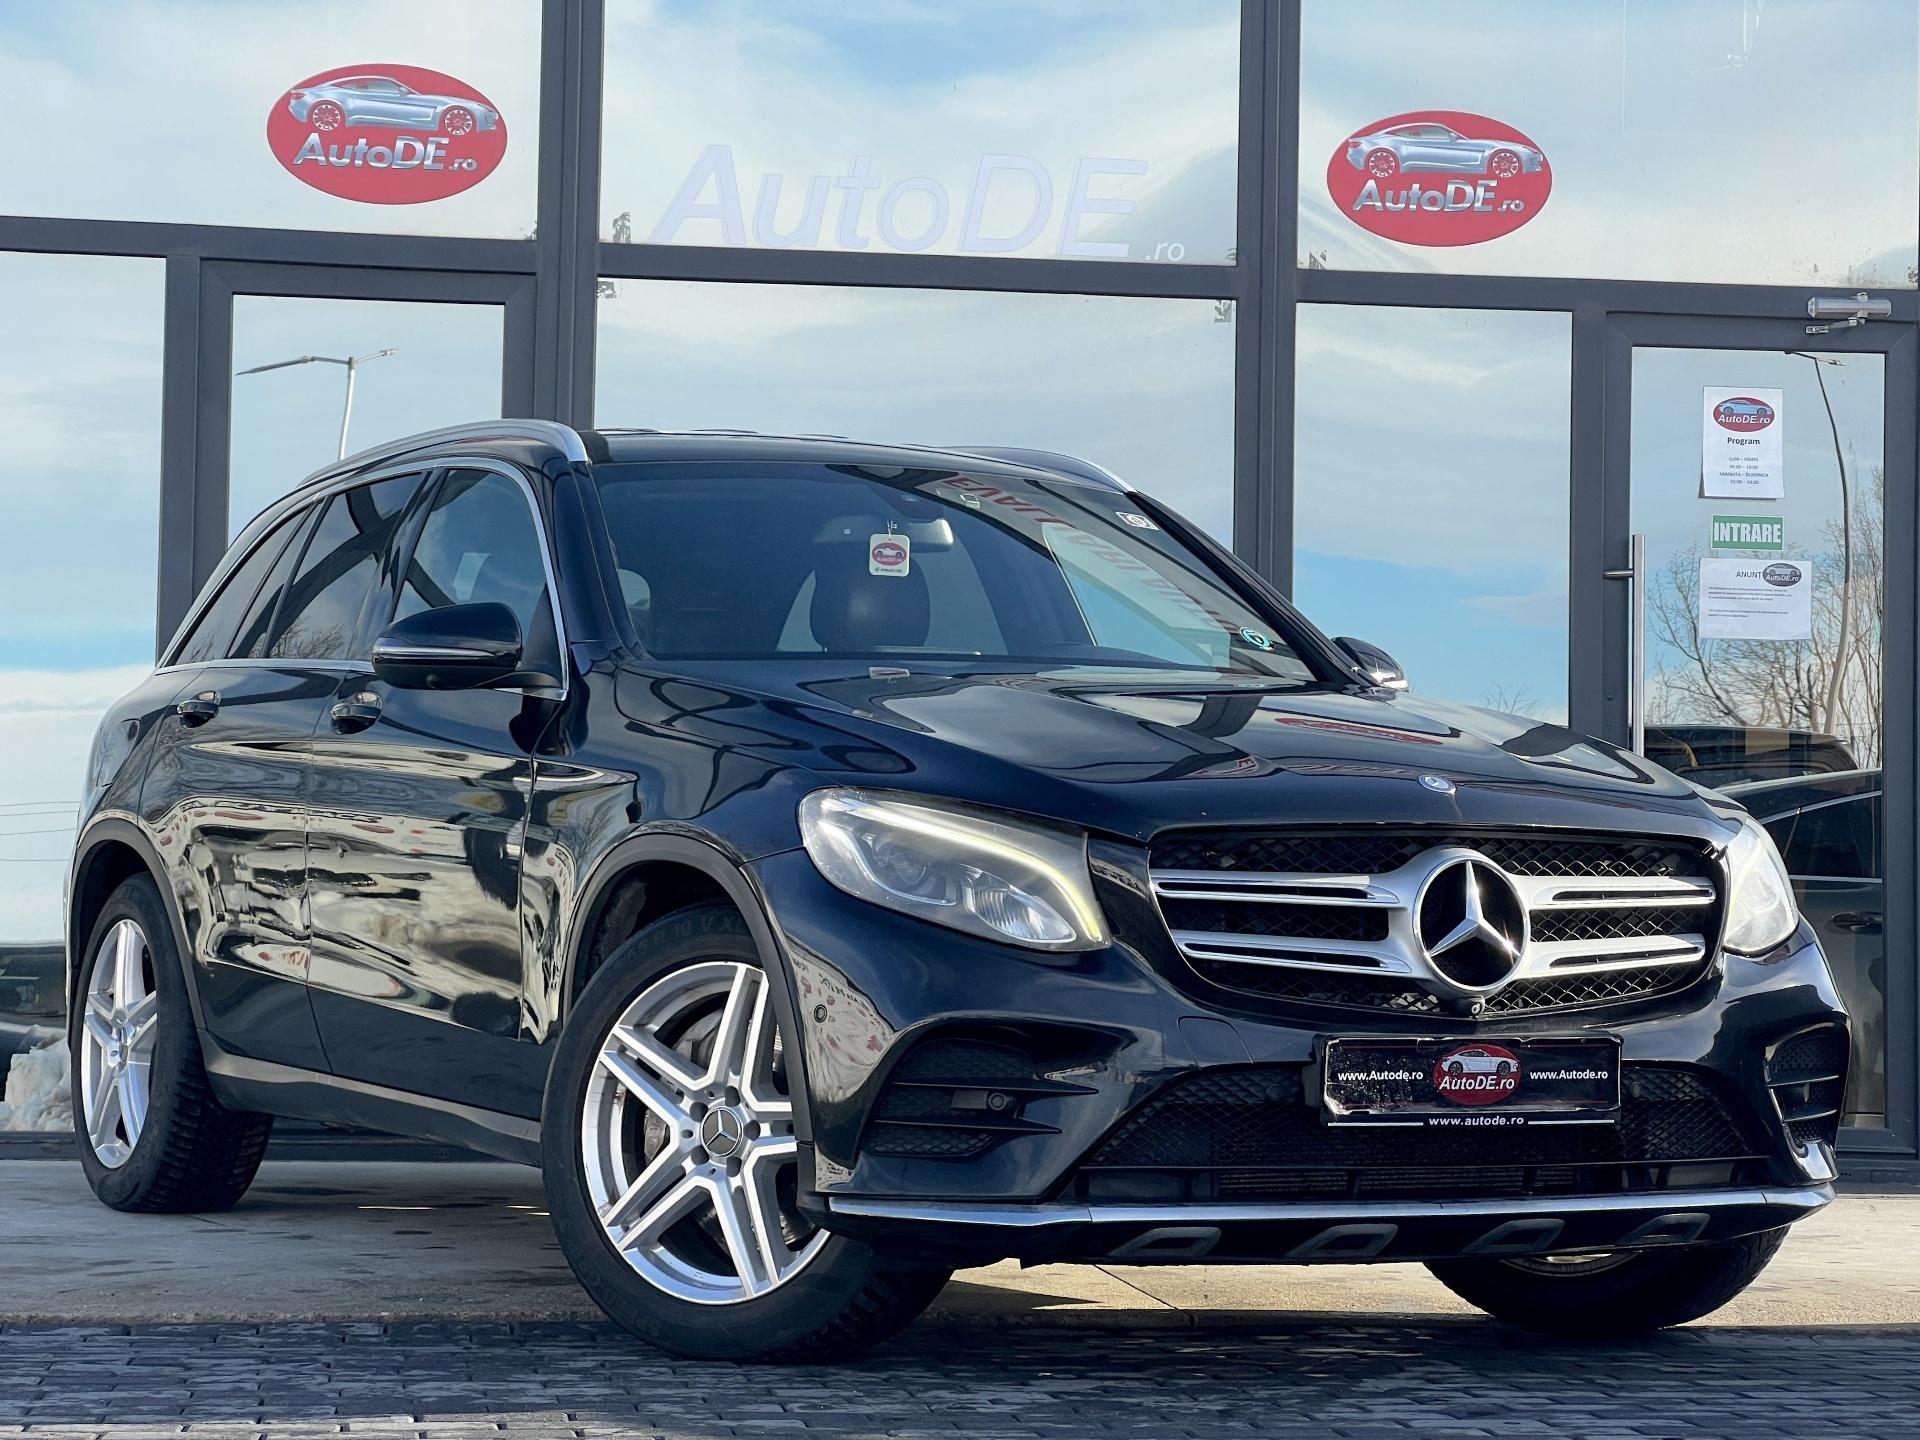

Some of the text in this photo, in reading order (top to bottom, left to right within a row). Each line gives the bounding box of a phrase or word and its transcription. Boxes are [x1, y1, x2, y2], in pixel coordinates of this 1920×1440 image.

[1718, 414, 1771, 425] AutoDE.ro
[1727, 437, 1761, 446] Program
[1713, 522, 1782, 543] INTRARE
[1765, 573, 1800, 582] AutoDE.ro
[1337, 1069, 1424, 1083] www.Autode.ro
[1529, 1068, 1609, 1081] www.Autode.ro
[1439, 1075, 1516, 1091] AutoDE.ro
[1428, 1115, 1525, 1127] www.autode.ro
